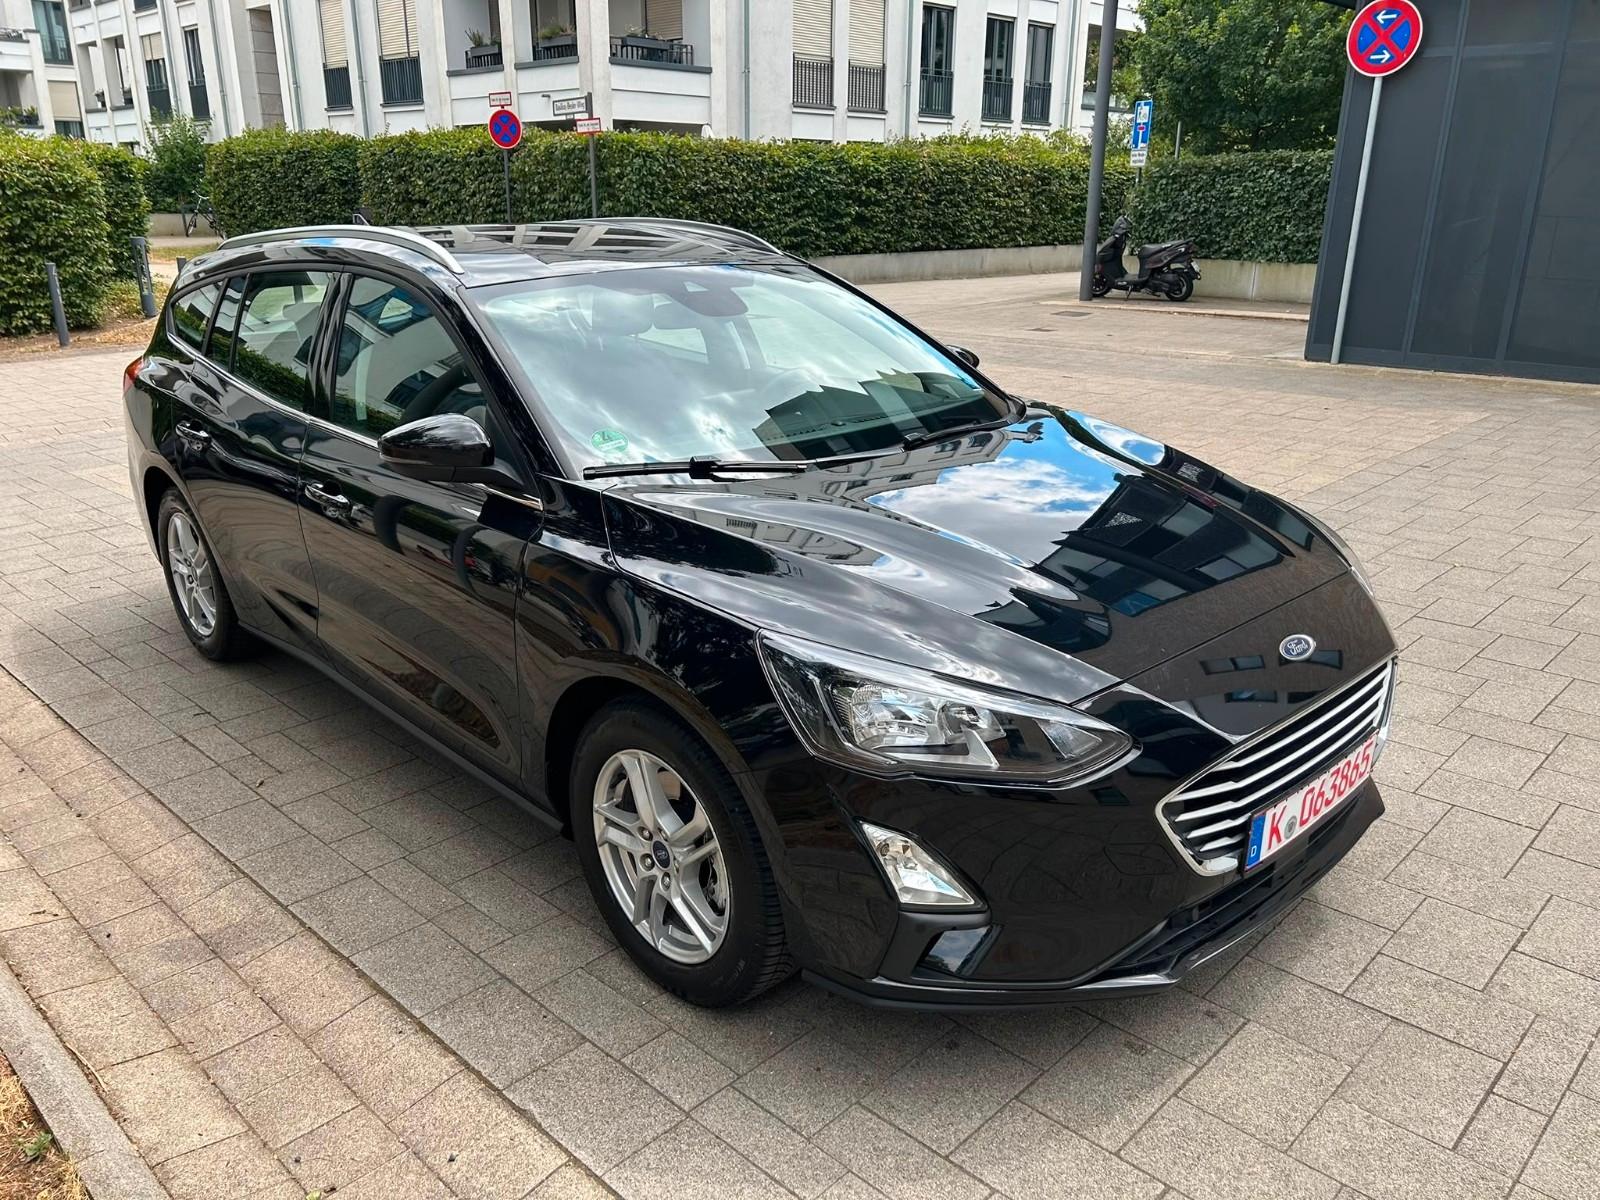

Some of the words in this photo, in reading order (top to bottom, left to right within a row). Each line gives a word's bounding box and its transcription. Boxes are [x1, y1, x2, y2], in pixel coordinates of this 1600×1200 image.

[1286, 639, 1309, 656] Ford
[1267, 804, 1288, 851] K
[1250, 845, 1258, 858] D
